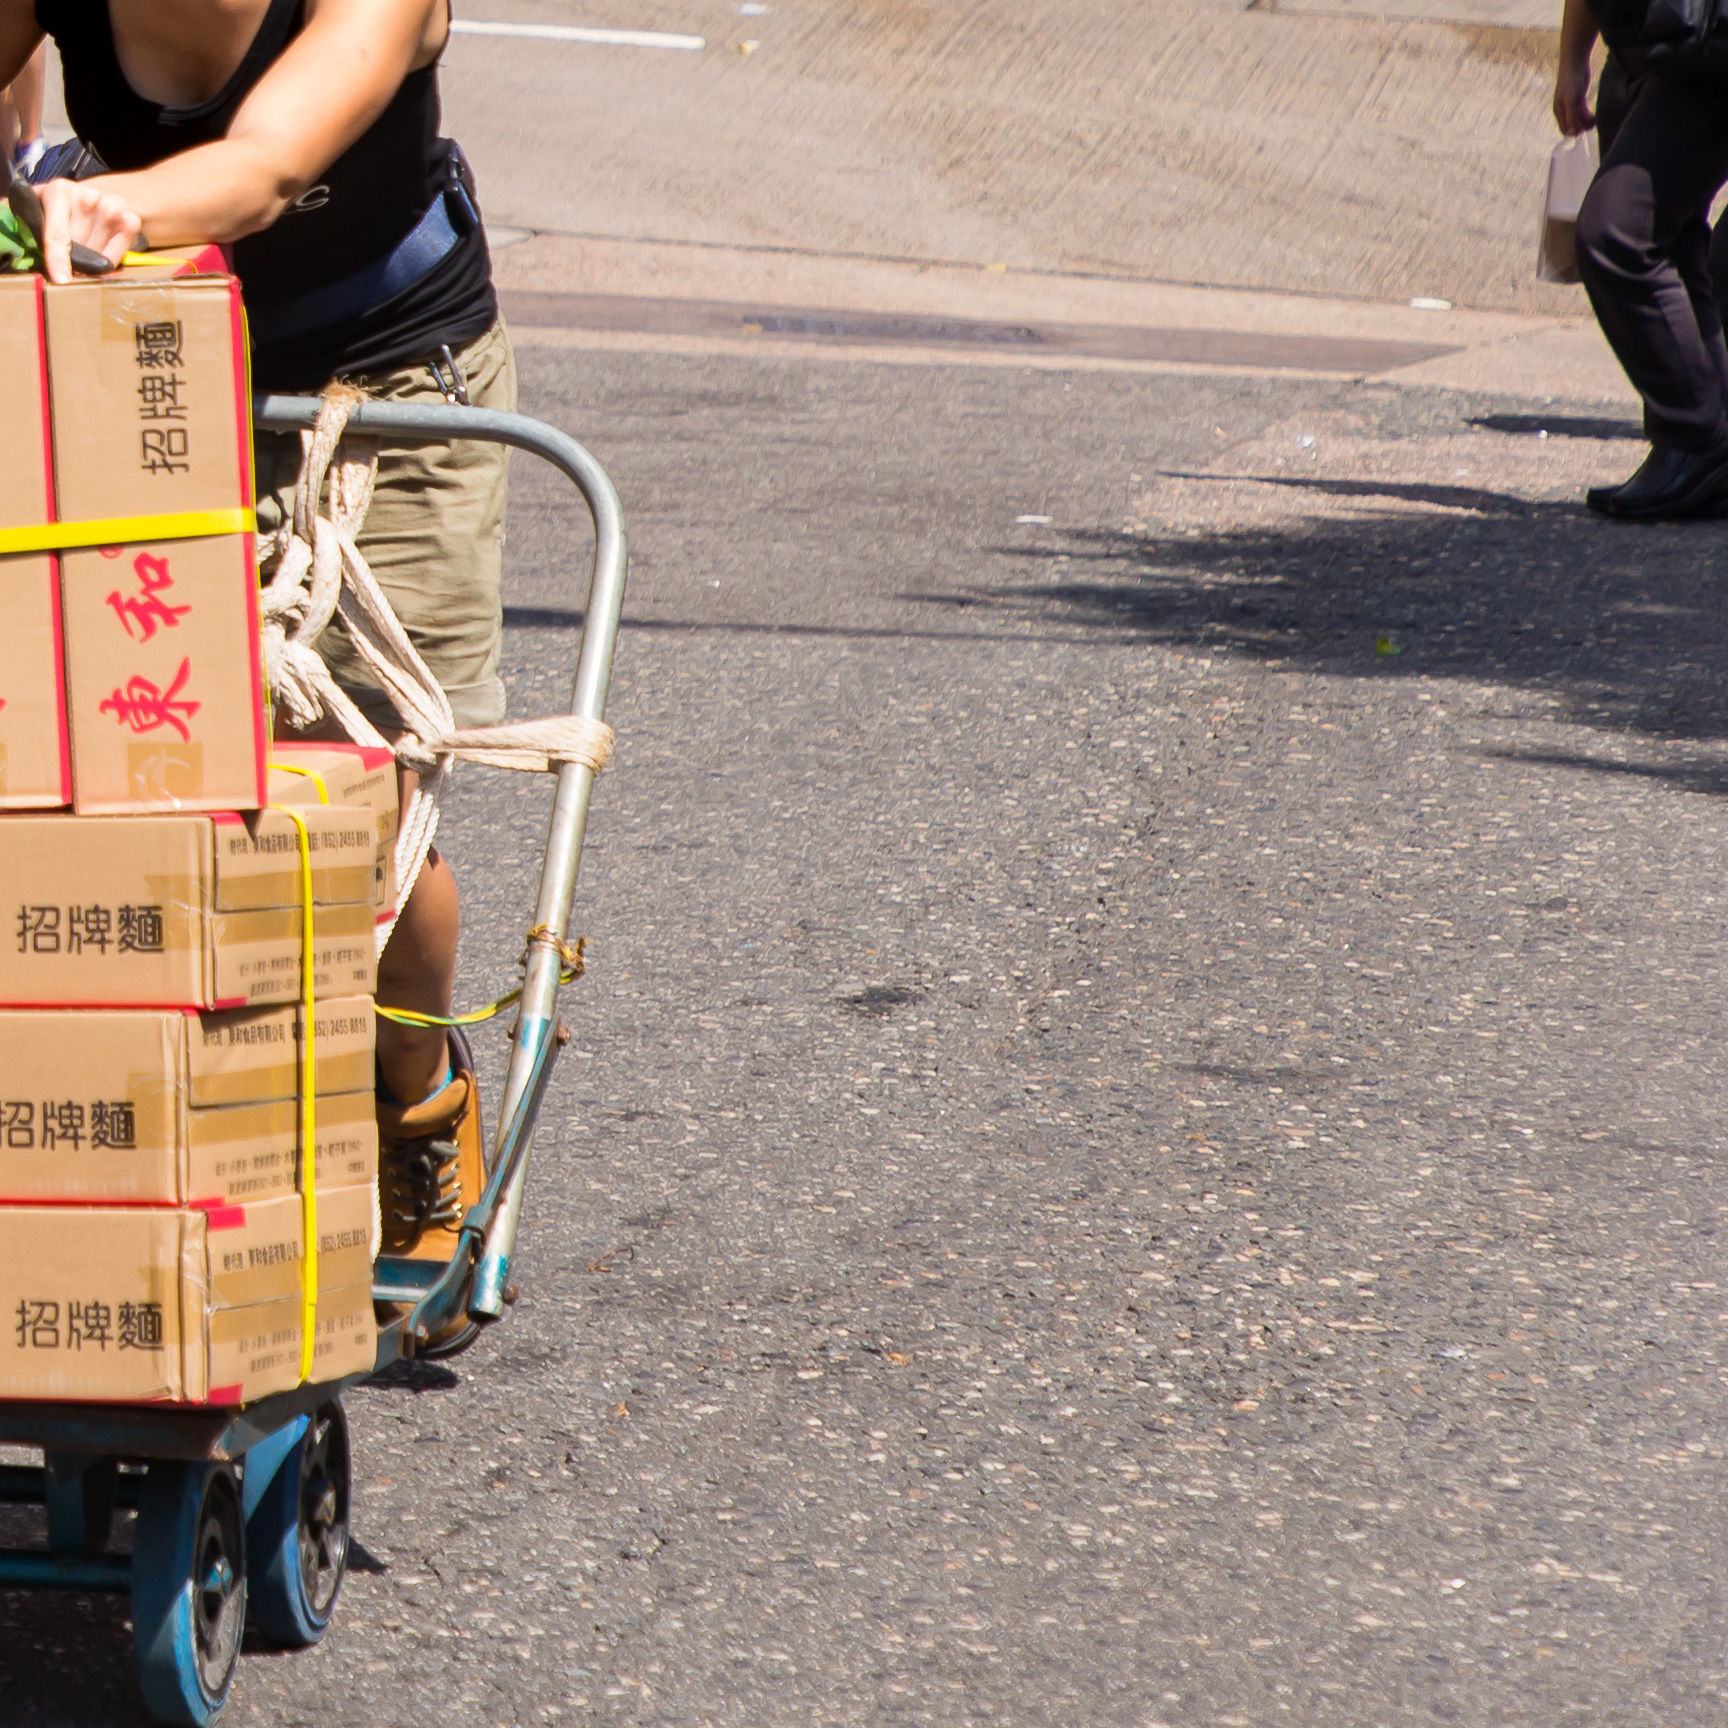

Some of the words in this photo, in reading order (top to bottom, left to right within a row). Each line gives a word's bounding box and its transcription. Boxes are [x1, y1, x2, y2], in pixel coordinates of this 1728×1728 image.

[134, 318, 190, 475] 招牌麵
[98, 550, 202, 744] 東和
[15, 903, 165, 955] 招牌麵
[14, 1299, 165, 1352] 招牌麵
